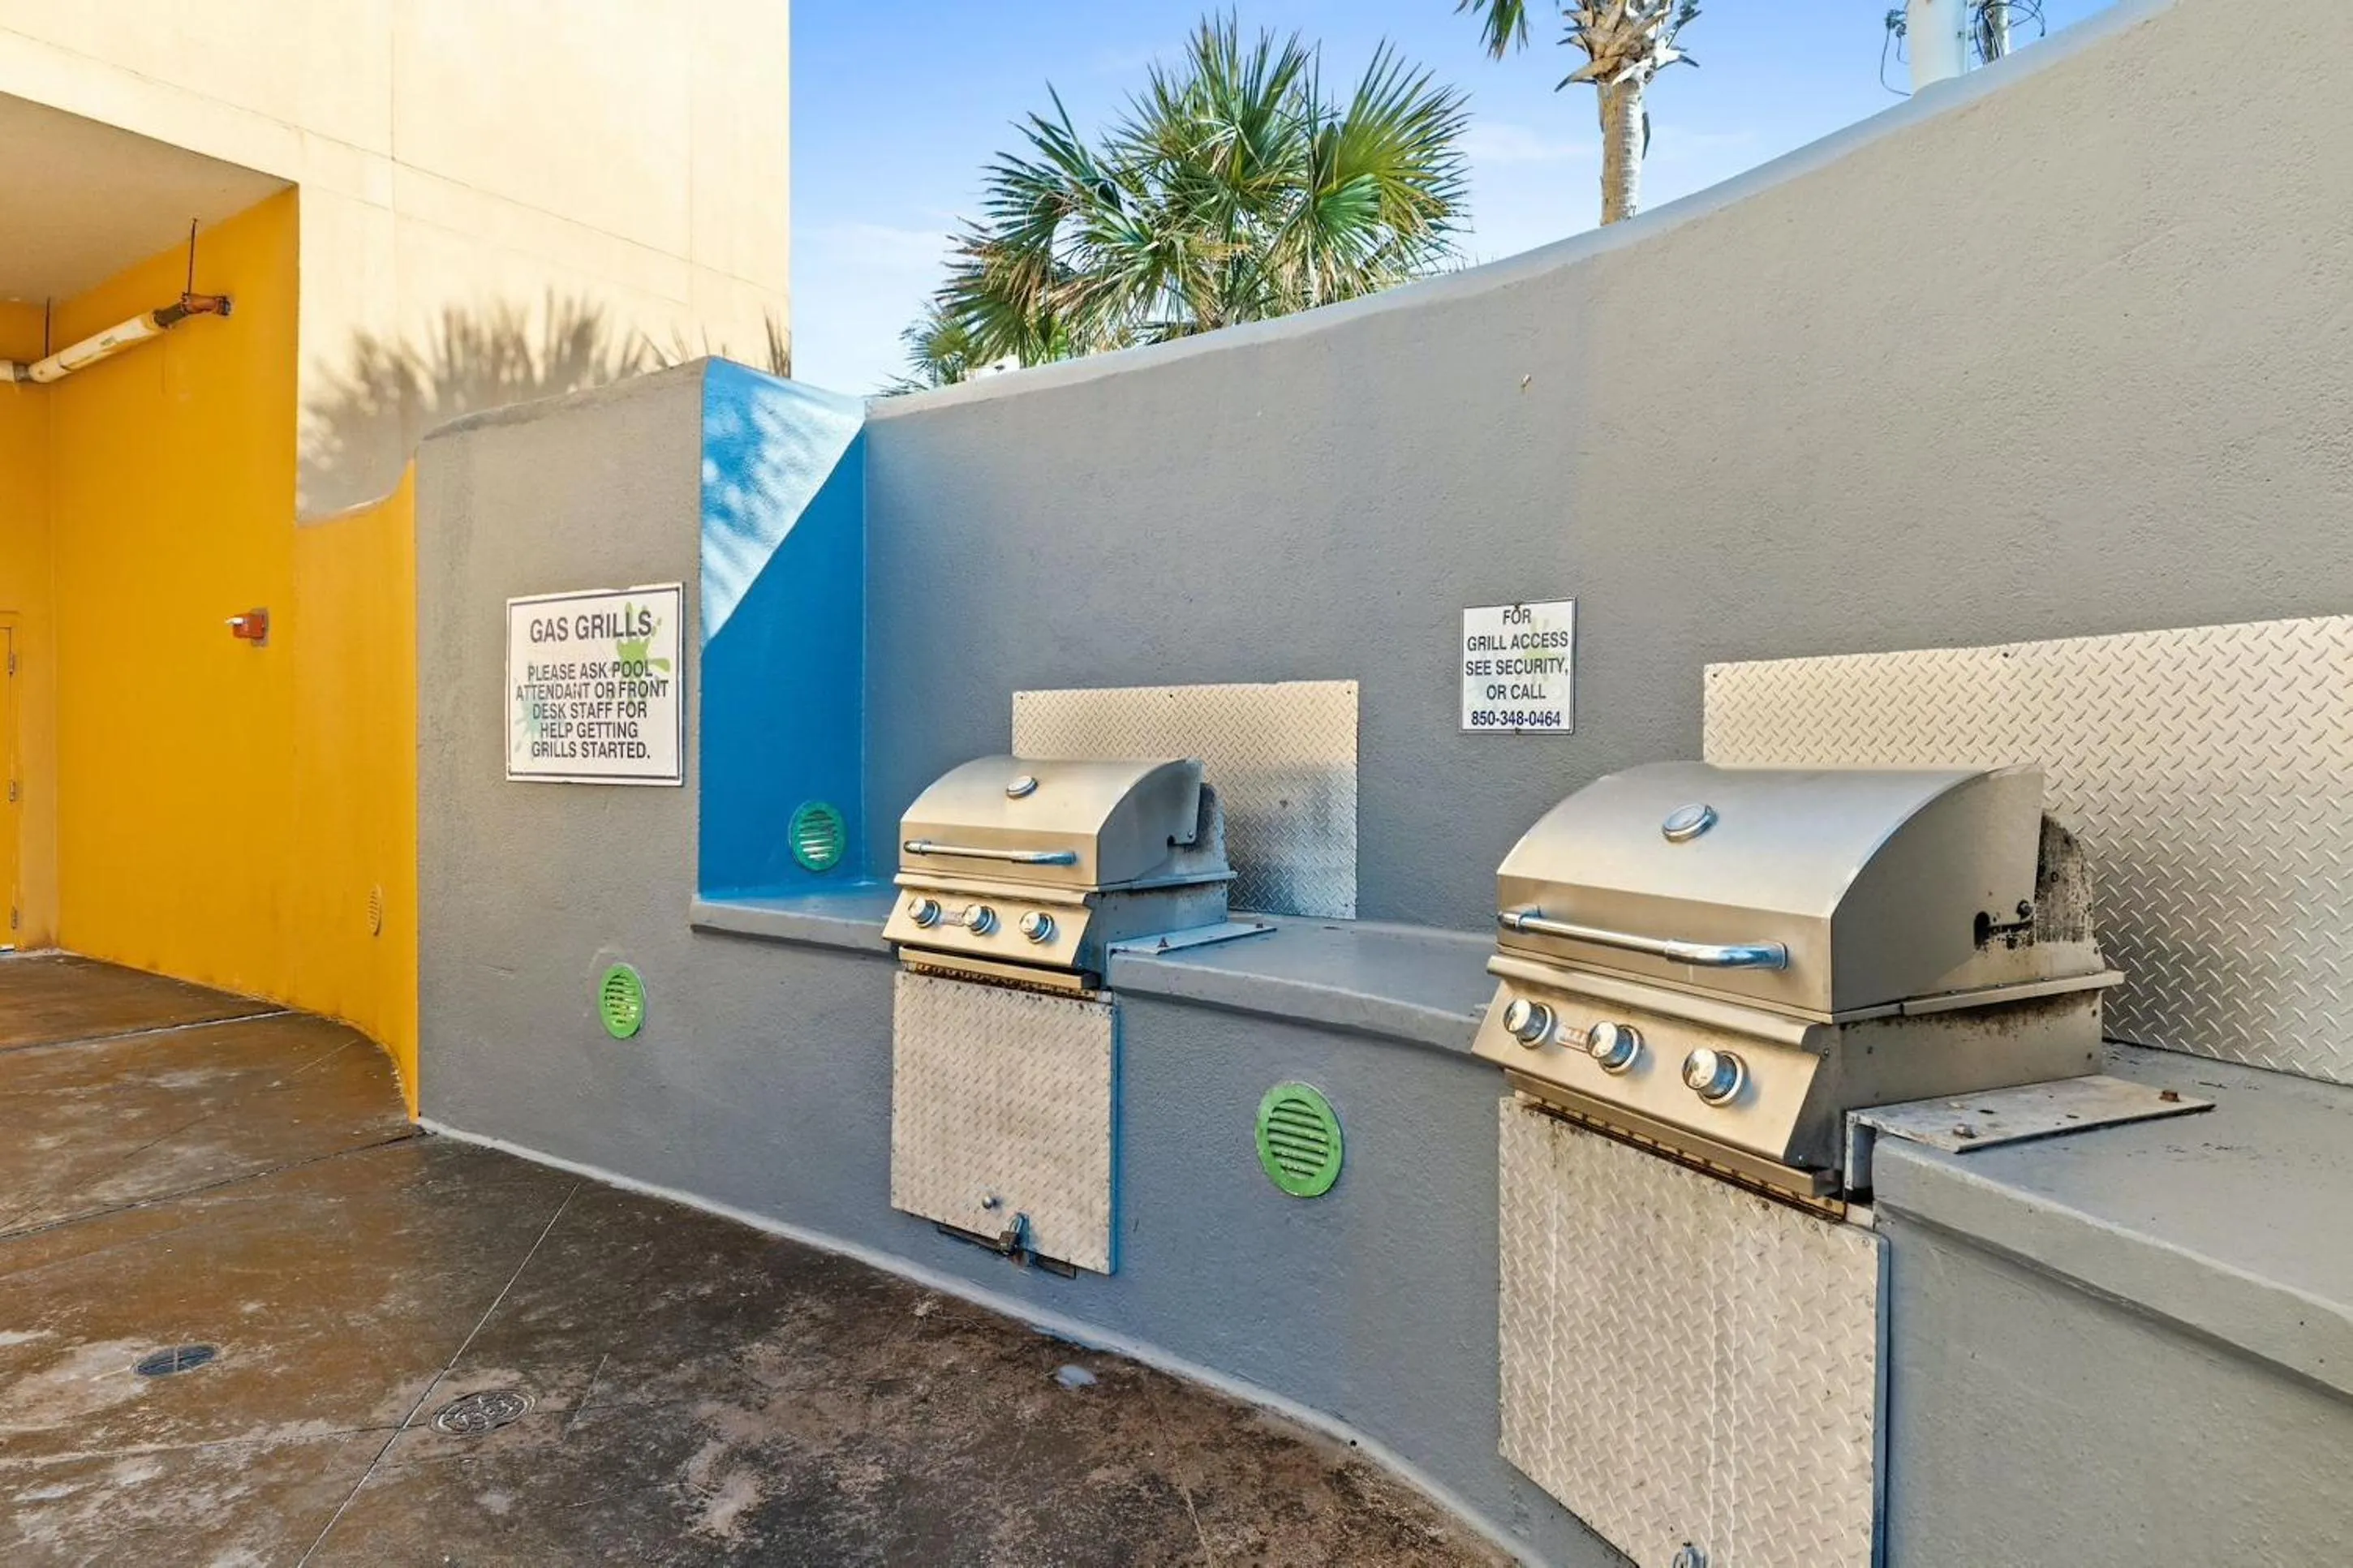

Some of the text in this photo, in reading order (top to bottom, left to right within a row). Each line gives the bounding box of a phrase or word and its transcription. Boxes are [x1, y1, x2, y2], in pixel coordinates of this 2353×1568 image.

[530, 609, 652, 642] GAS GRILLS
[1503, 608, 1532, 625] FOR
[1467, 631, 1568, 651] GRILL ACCESS
[528, 659, 653, 681] PLEASE ASK POOL
[1465, 657, 1568, 676] SEE SECURITY,
[516, 680, 669, 701] ATTENDANT OR FRONT
[1486, 685, 1546, 700] OR CALL
[532, 701, 647, 720] DESK STAFF FOR
[1471, 711, 1560, 726] 850-348-0464
[540, 721, 638, 738] HELP GETTING
[531, 741, 650, 758] GRILLS STARTED.
